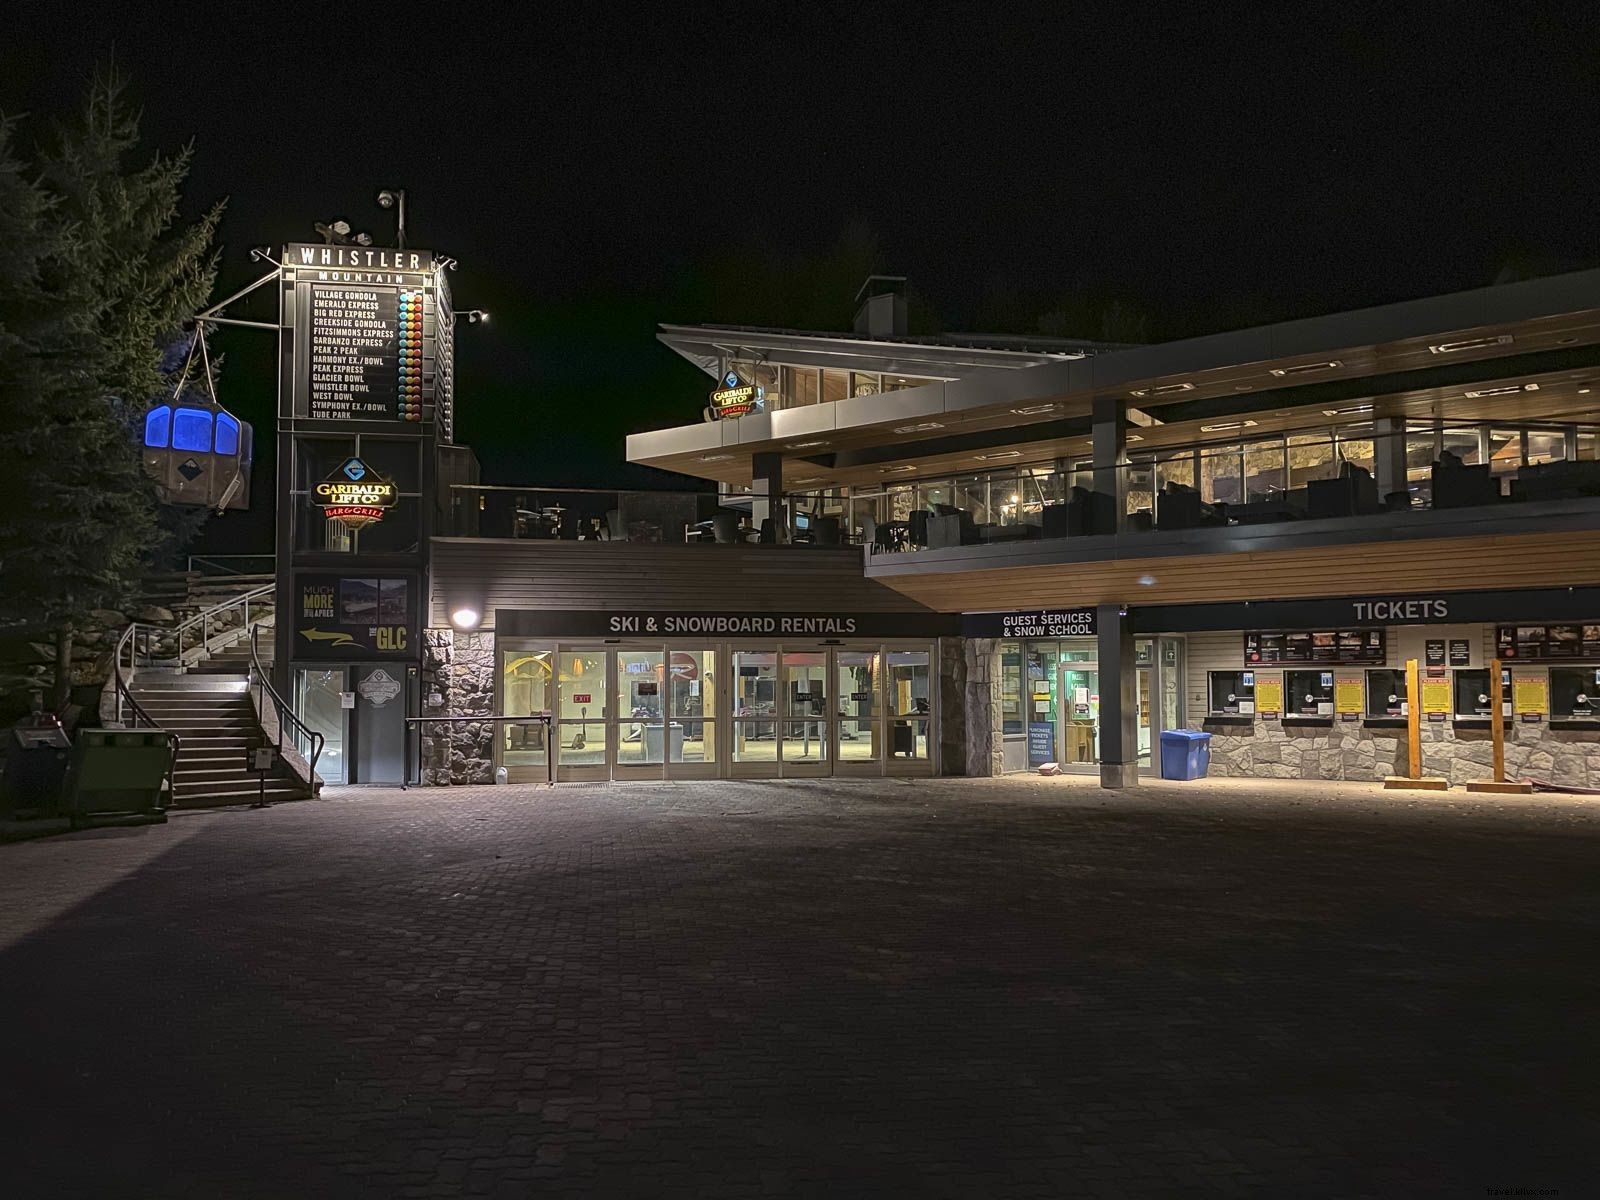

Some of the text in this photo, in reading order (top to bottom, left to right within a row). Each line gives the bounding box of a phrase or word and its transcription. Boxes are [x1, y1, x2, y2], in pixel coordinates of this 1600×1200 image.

[301, 248, 419, 268] WHISTLER
[319, 272, 403, 284] MOUNTAIN
[345, 292, 377, 300] GONDOLA
[314, 300, 378, 310] EMERALD EXPRESS
[345, 311, 375, 319] EXPRESS
[314, 318, 386, 328] CREEKSIDE GONDOLA
[314, 328, 361, 336] FITZSIMMONS
[314, 337, 350, 345] GARBANZO
[313, 374, 342, 382] GLACIER
[312, 401, 350, 409] SYMPHONY
[316, 484, 390, 495] GARIBALDI
[331, 494, 361, 504] LIFT
[304, 594, 334, 608] MORE
[1352, 600, 1448, 620] TICKETS
[610, 616, 856, 632] SKI & SNOWBOARD RENTALS
[1003, 613, 1092, 626] GUEST SERVICES
[1004, 624, 1092, 637] & SNOW SCHOOL
[376, 627, 407, 650] GLC
